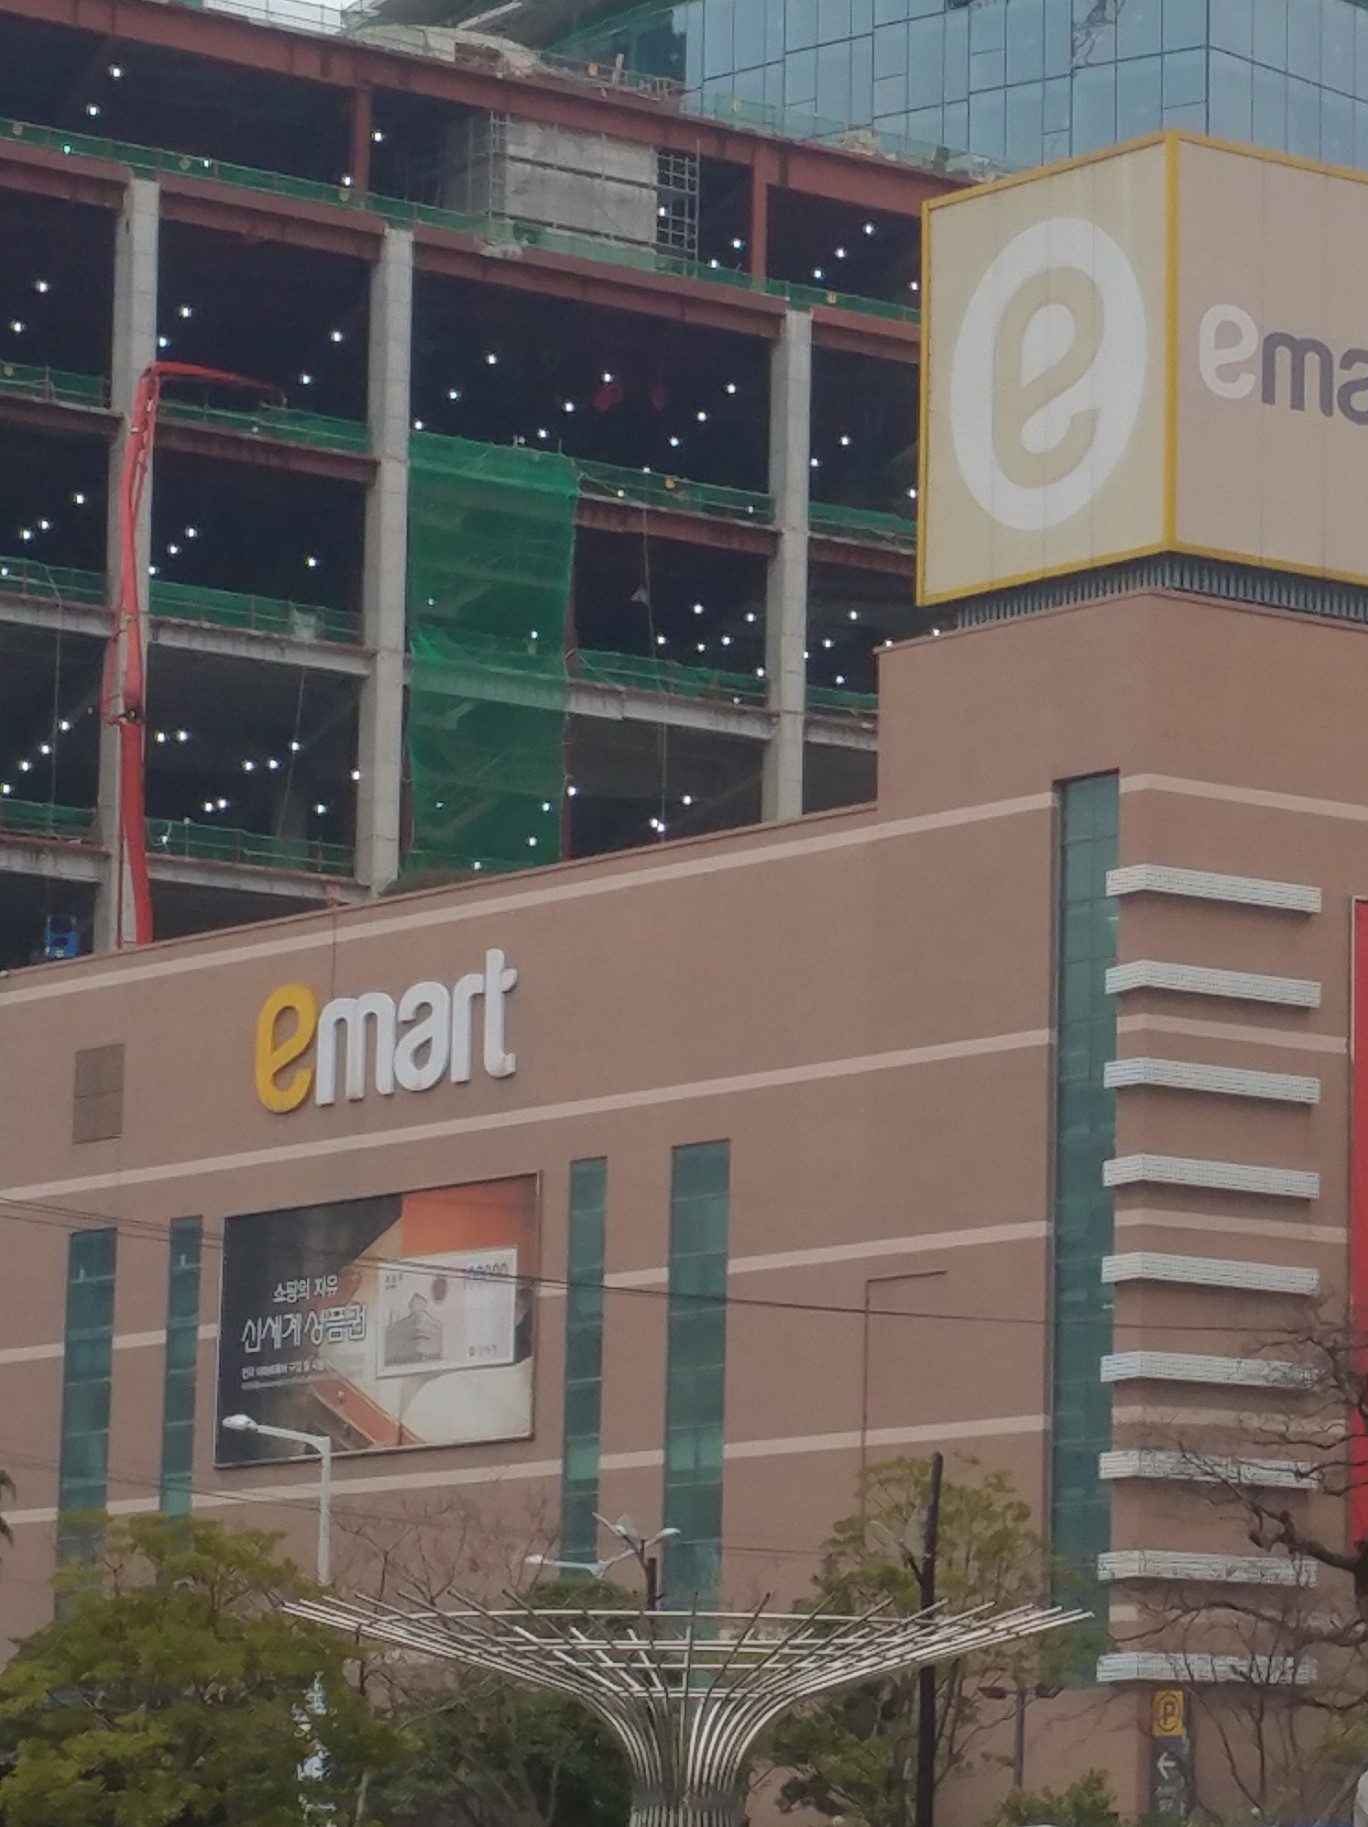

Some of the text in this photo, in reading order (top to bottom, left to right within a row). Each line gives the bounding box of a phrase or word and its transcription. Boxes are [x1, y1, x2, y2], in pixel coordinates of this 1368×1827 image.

[255, 948, 518, 1113] emart
[314, 1274, 339, 1298] 자유
[241, 1304, 367, 1354] 신세계 상품권
